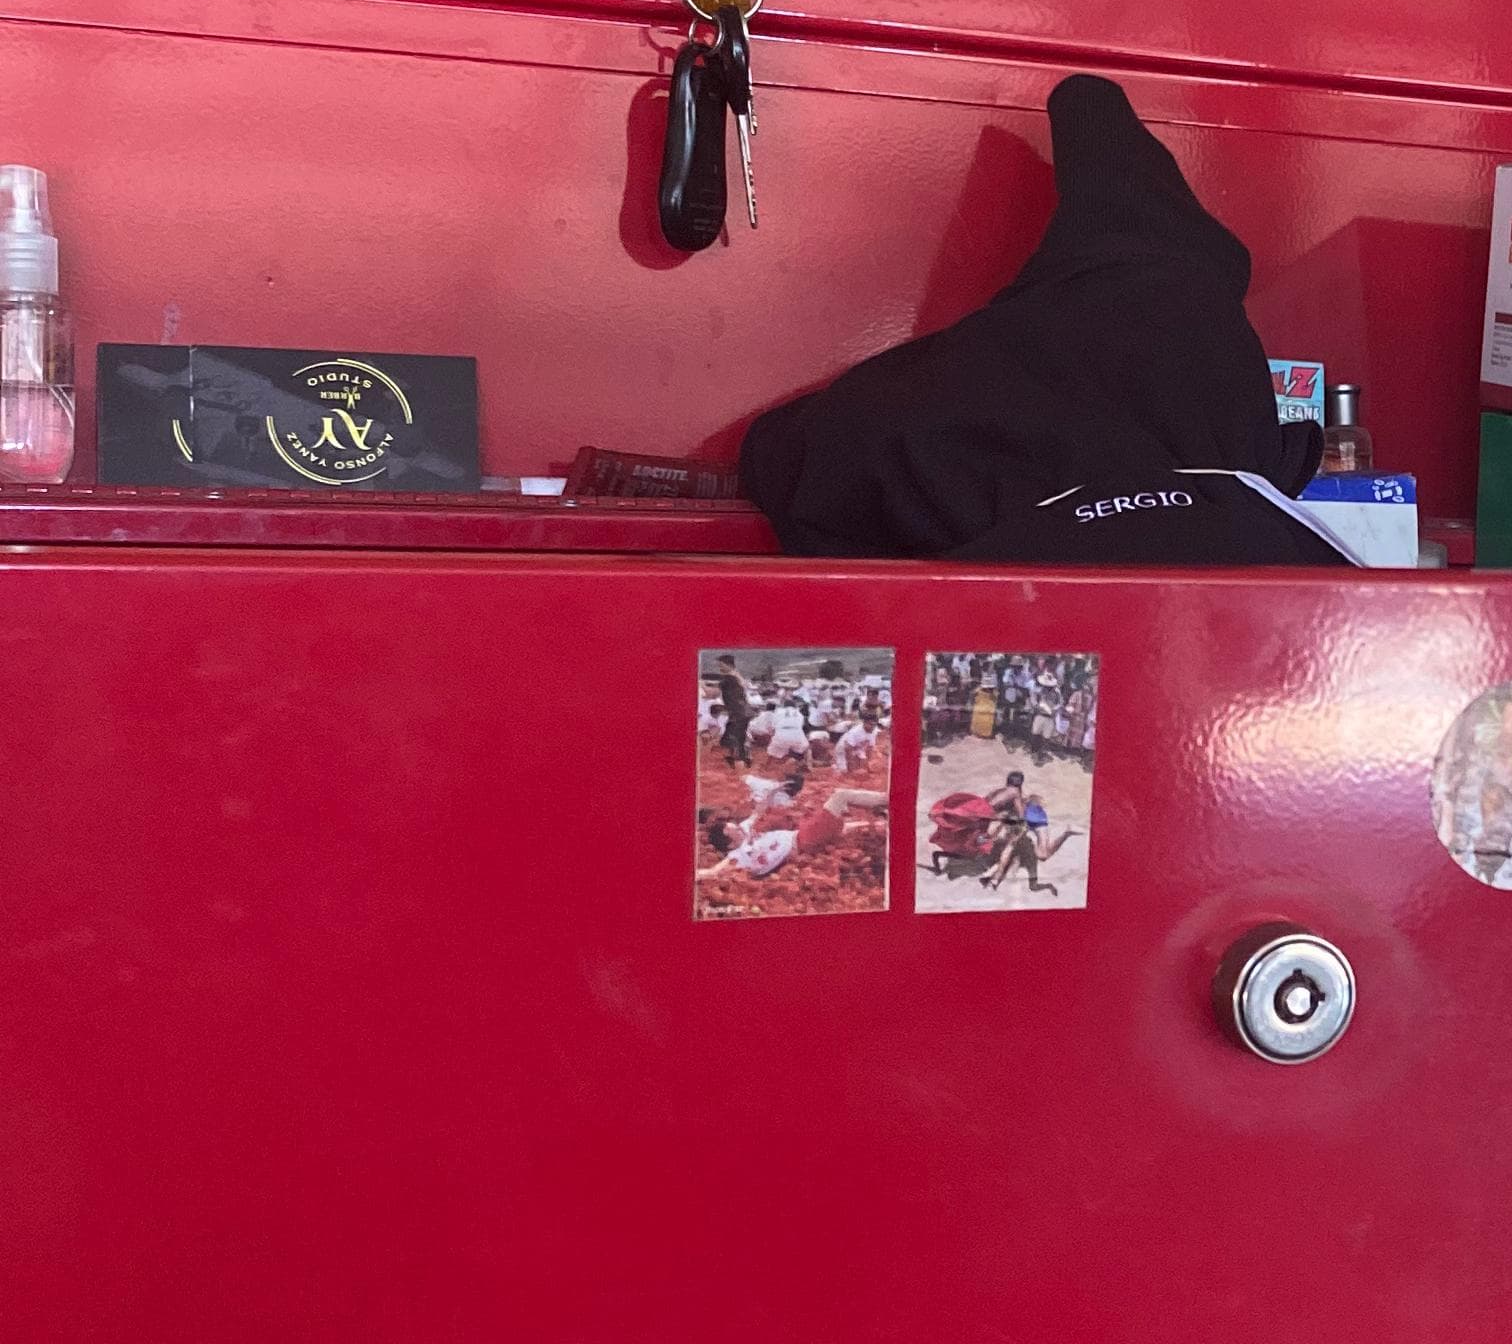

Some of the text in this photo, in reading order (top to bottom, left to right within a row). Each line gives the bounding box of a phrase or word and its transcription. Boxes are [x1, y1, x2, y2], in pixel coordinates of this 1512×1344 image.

[307, 373, 373, 389] STUDIO
[320, 391, 361, 400] BRBER
[311, 409, 374, 450] AY
[286, 431, 394, 469] ALFONSO YANEZ
[632, 465, 688, 481] LOCTITE
[1075, 491, 1193, 523] SERGIO
